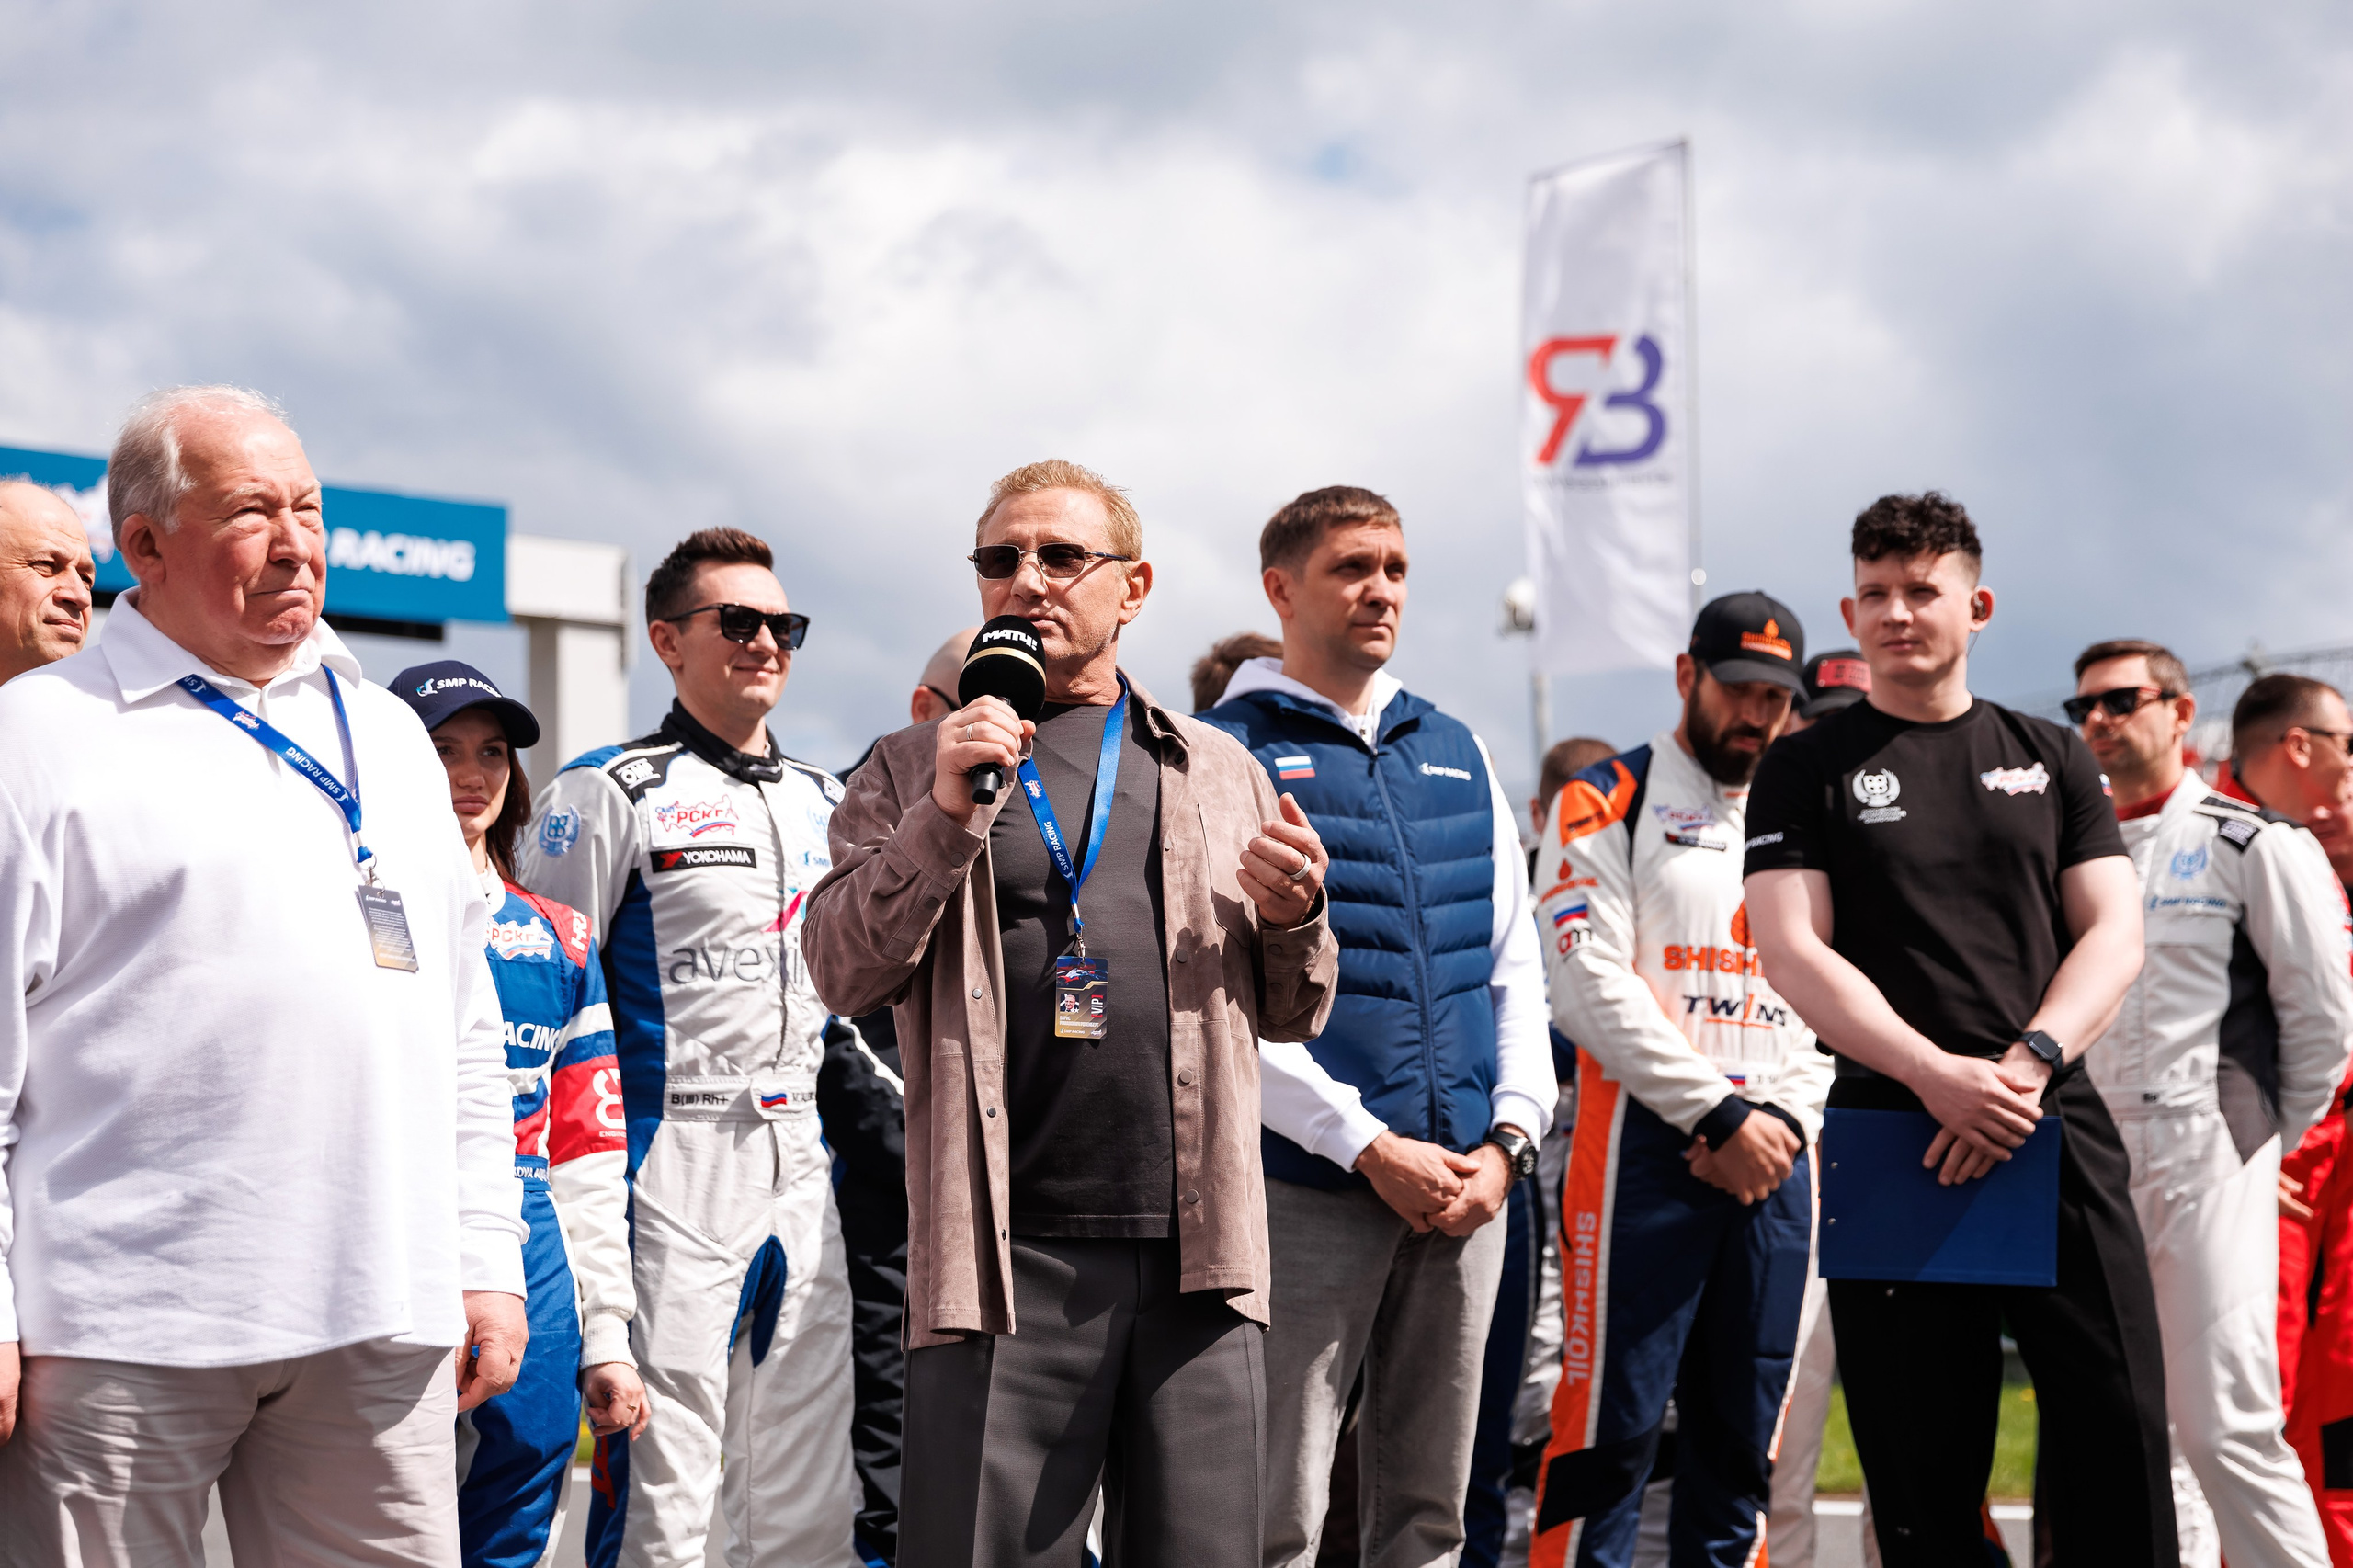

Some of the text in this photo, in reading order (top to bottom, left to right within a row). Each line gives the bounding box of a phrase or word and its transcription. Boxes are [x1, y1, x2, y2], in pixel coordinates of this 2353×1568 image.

[327, 527, 476, 582] RACING
[437, 678, 467, 690] SMP
[286, 746, 342, 795] SMP RACING
[684, 850, 751, 864] YOKOHAMA
[1043, 821, 1069, 871] SMP RACING
[1664, 945, 1765, 978] SHISH
[702, 1094, 729, 1105] Rh+
[1567, 1210, 1597, 1386] SHISHKOIL
